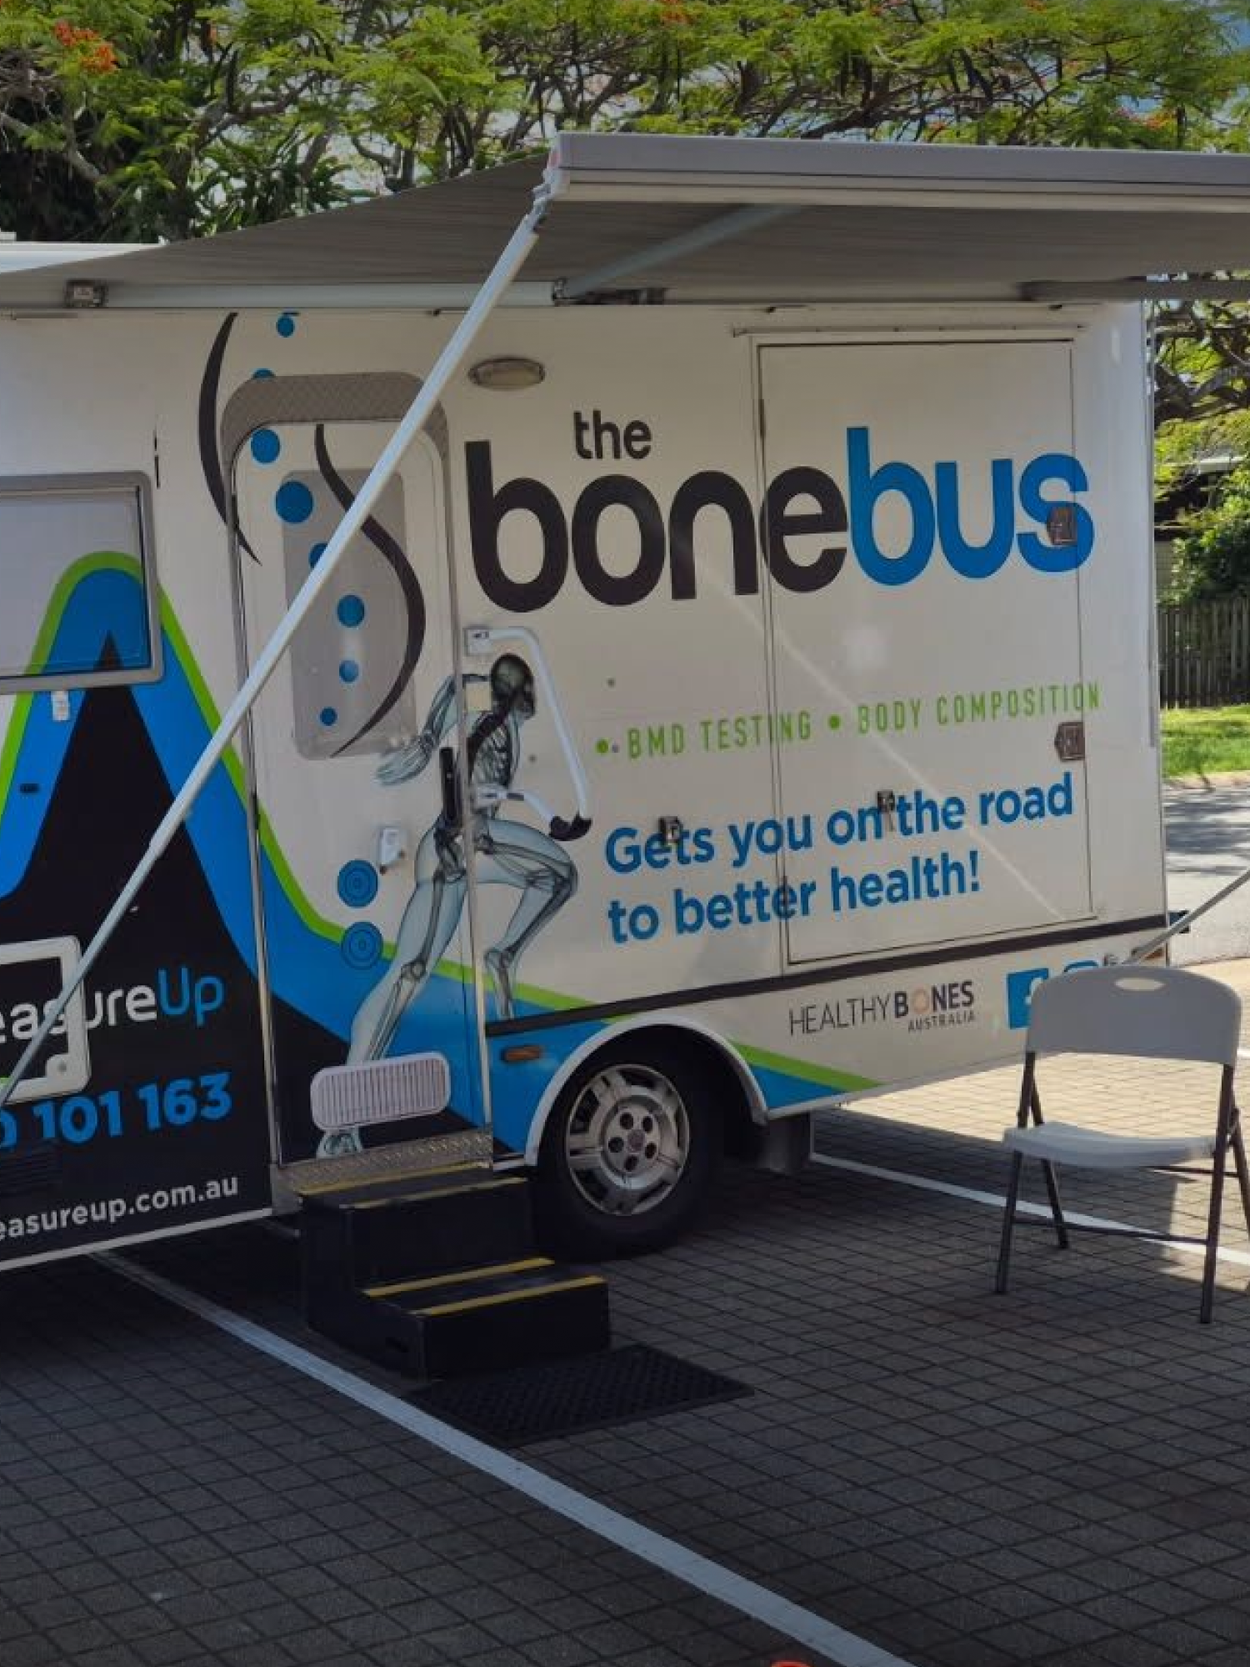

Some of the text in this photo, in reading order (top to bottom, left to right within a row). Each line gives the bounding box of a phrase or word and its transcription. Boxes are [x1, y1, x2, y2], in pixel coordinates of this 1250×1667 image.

[573, 410, 652, 460] the
[628, 682, 1101, 759] BMD TESTING BODY COMPOSITION
[605, 771, 1074, 874] Gets you on the road
[608, 850, 980, 943] to better health!
[908, 1010, 975, 1033] AUSTRALIA
[34, 1090, 121, 1144] 101
[138, 1072, 232, 1130] 163
